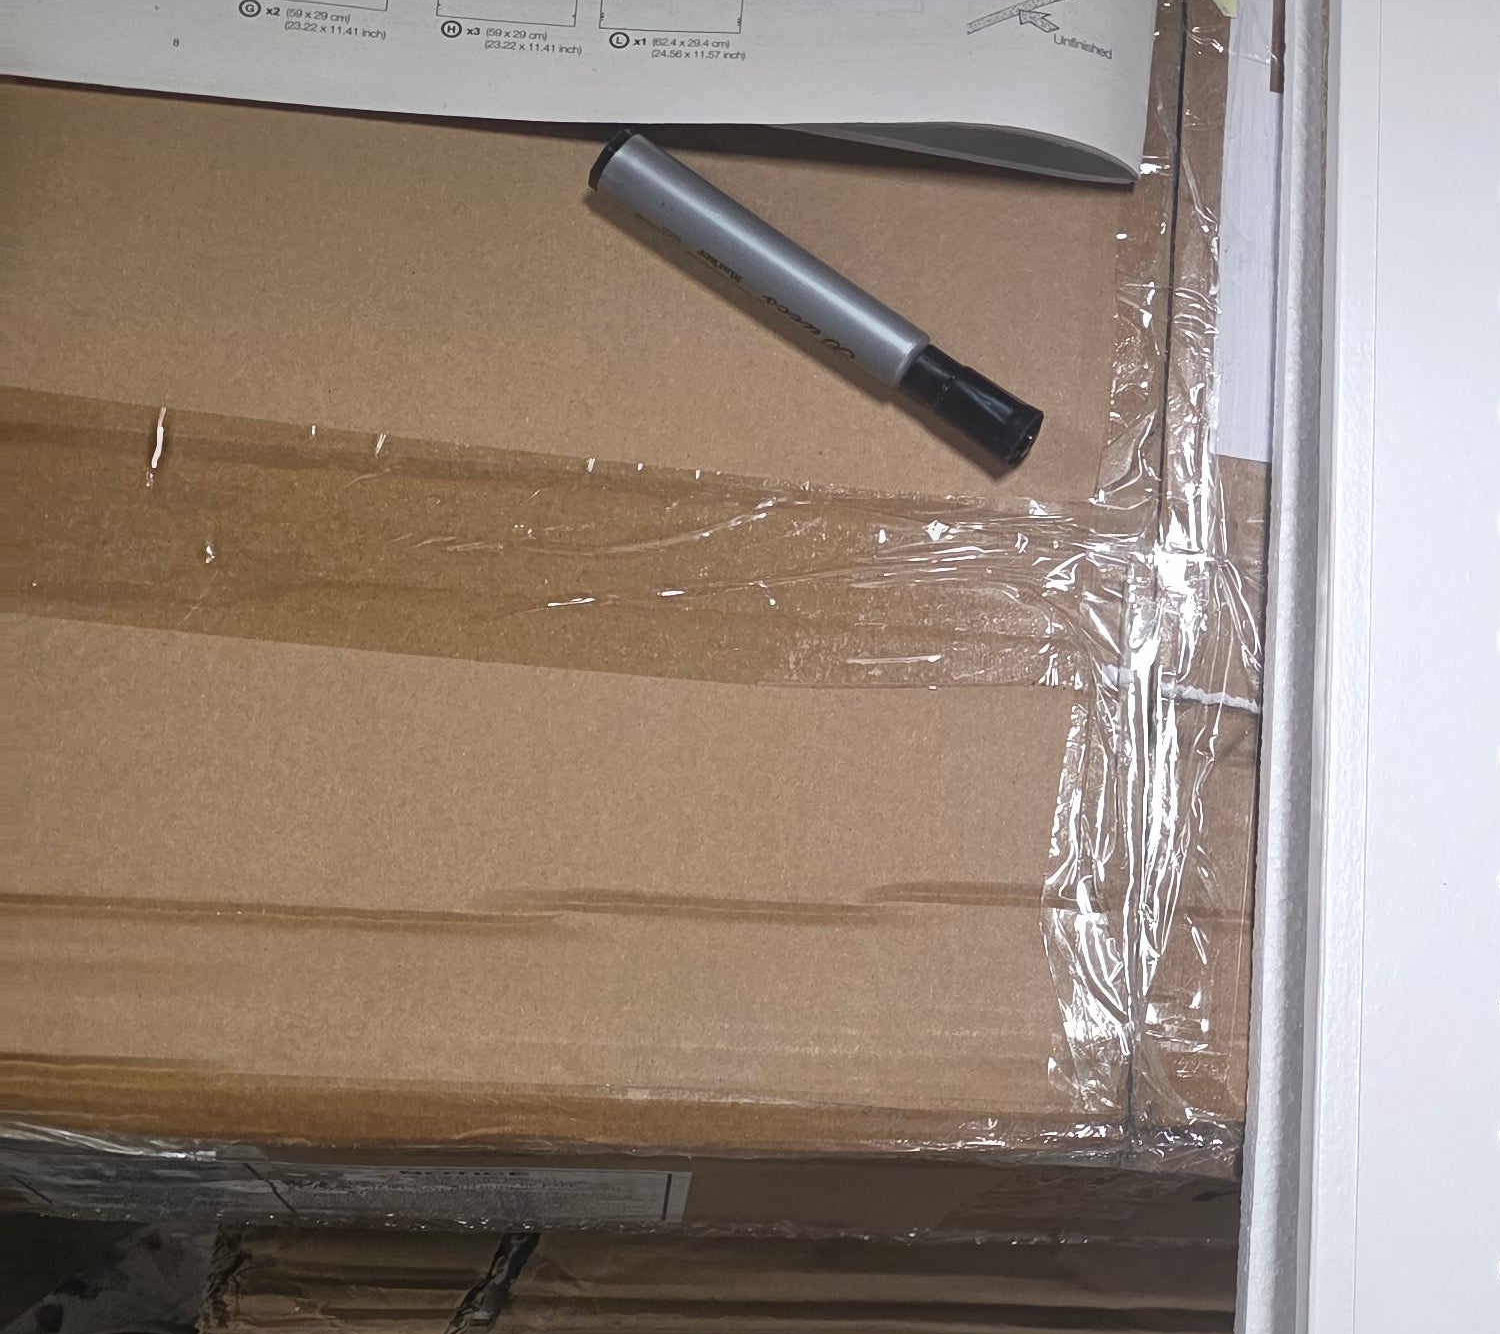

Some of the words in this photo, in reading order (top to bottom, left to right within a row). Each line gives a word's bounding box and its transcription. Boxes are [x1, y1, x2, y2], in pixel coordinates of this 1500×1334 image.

[265, 7, 281, 17] x2
[466, 27, 481, 36] x3
[633, 38, 647, 47] x1
[1053, 33, 1113, 60] Unfinished
